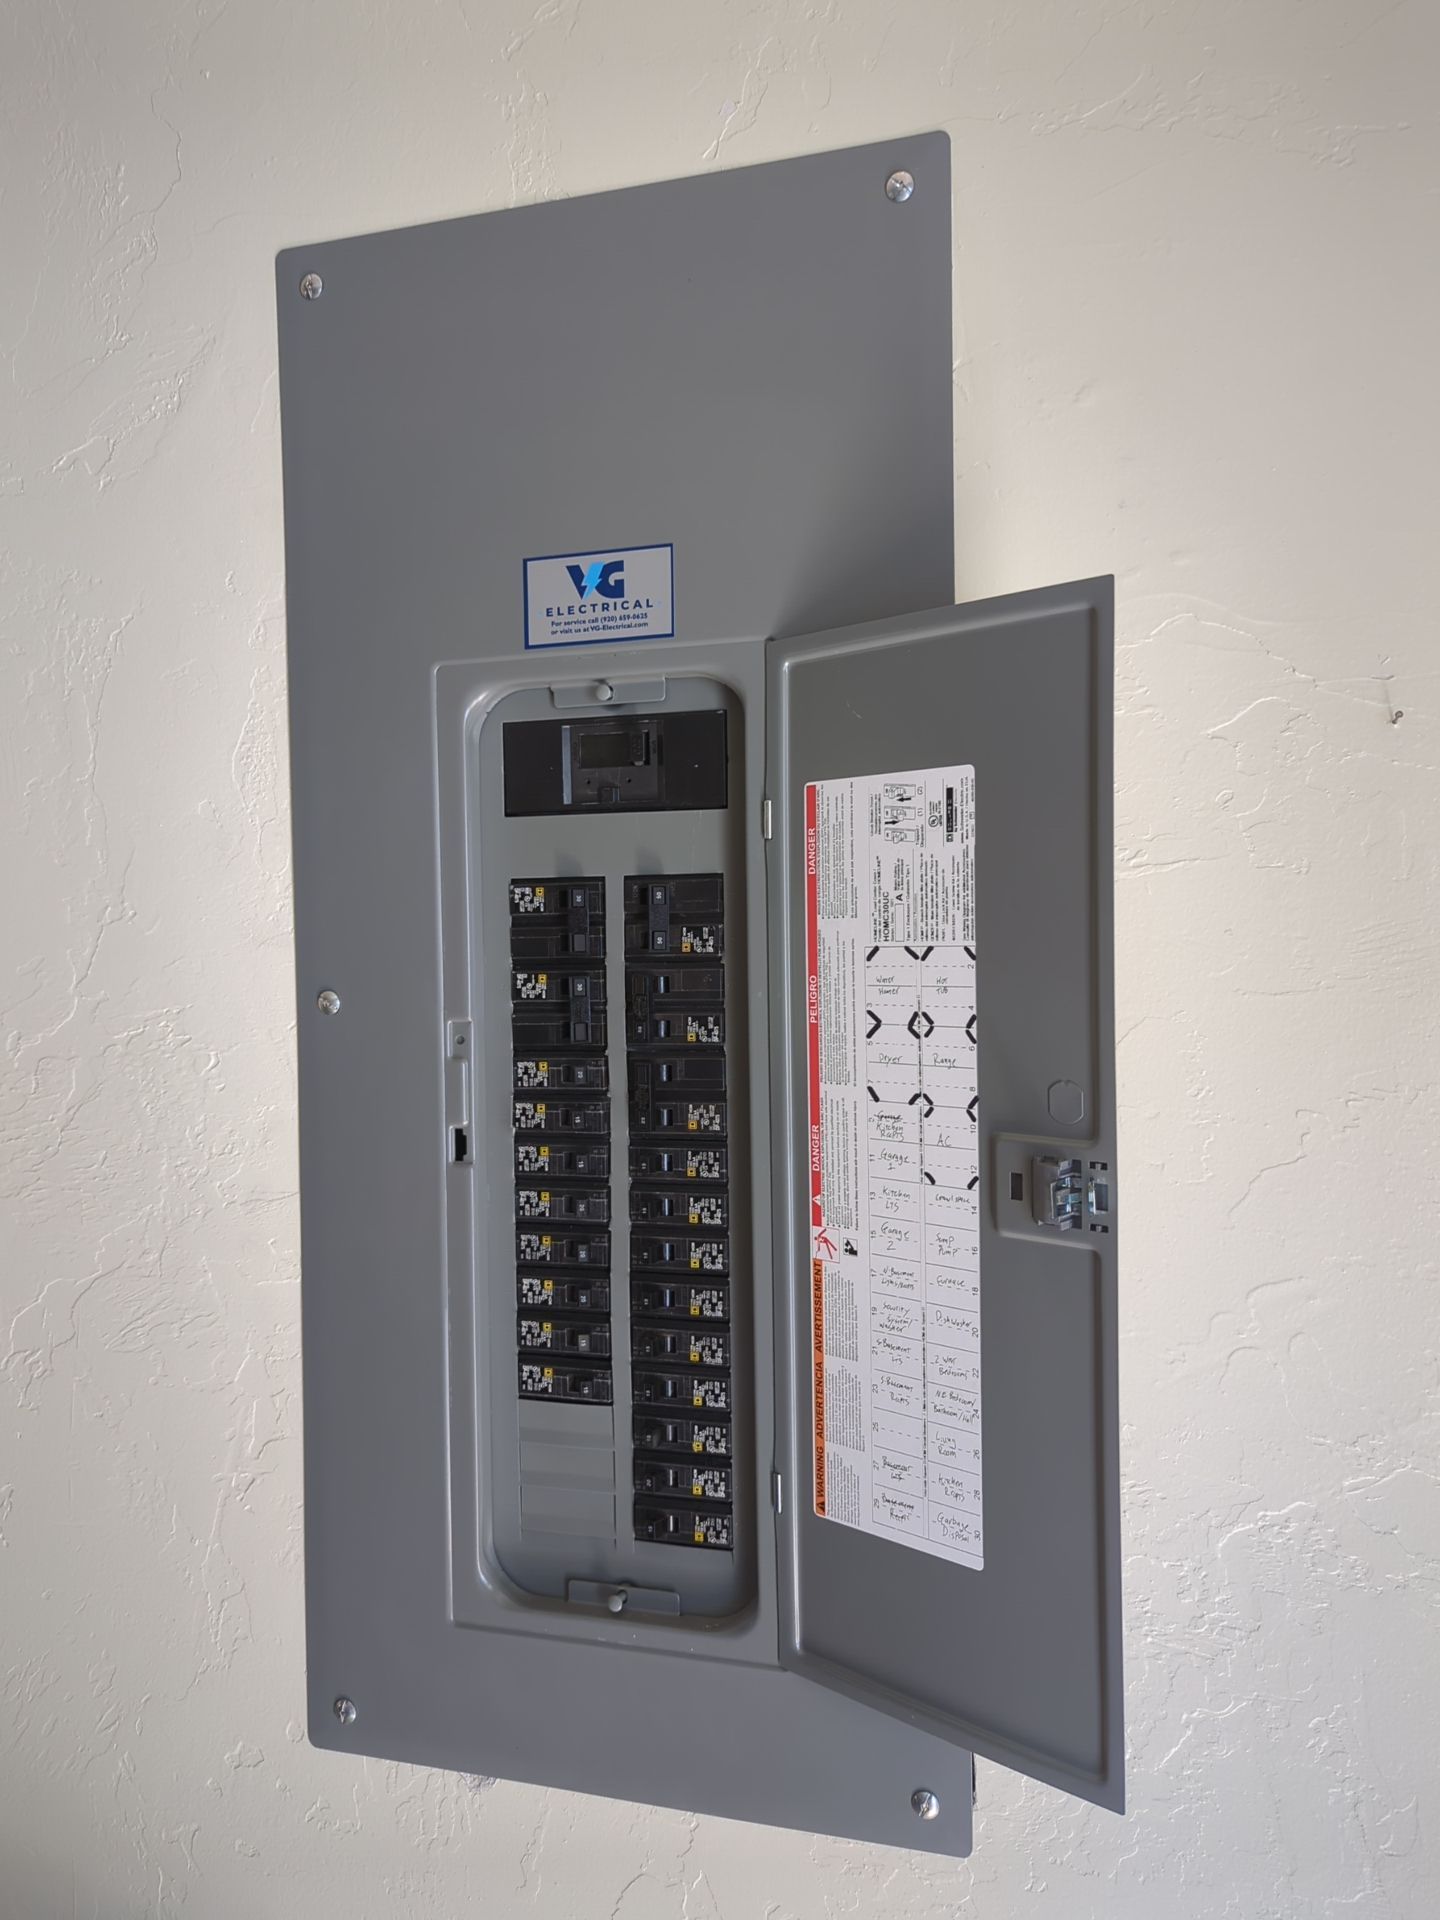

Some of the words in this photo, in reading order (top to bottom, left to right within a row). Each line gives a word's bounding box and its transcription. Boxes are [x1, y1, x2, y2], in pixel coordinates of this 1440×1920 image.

[565, 559, 625, 601] VG
[545, 598, 654, 618] ELECTRICAL
[551, 620, 563, 628] For
[563, 618, 587, 627] service
[587, 616, 600, 625] call
[600, 615, 618, 625] (920)
[559, 626, 573, 635] visit
[590, 620, 649, 632] VG-Electrical.com
[808, 827, 817, 876] DANGER
[895, 893, 904, 902] A
[882, 891, 890, 943] HOMC30UC
[809, 975, 819, 1024] PELIGRO
[932, 1052, 957, 1070] Range
[970, 1124, 977, 1134] 10
[937, 1132, 952, 1147] AC
[811, 1124, 821, 1173] DANGER
[869, 1153, 875, 1162] 11
[880, 1147, 910, 1166] Garage
[970, 1164, 977, 1175] 12
[869, 1191, 876, 1201] 13
[971, 1205, 978, 1215] 14
[870, 1230, 877, 1239] 15
[880, 1221, 910, 1242] Garage
[886, 1240, 897, 1251] 2
[971, 1246, 979, 1256] 16
[870, 1268, 877, 1277] 17
[971, 1286, 979, 1296] 18
[812, 1260, 824, 1353] AVERTISSEMENT
[871, 1306, 878, 1316] 19
[971, 1327, 980, 1339] 20
[871, 1346, 879, 1356] 21
[972, 1367, 980, 1379] 22
[871, 1383, 879, 1394] 23
[814, 1361, 825, 1440] ADVERTENCIA
[973, 1408, 980, 1420] 24
[872, 1421, 880, 1433] 25
[972, 1449, 981, 1460] 26
[872, 1460, 880, 1471] 27
[815, 1446, 825, 1498] WARNING
[973, 1489, 981, 1501] 28
[873, 1498, 880, 1509] 29
[974, 1529, 982, 1542] 30
